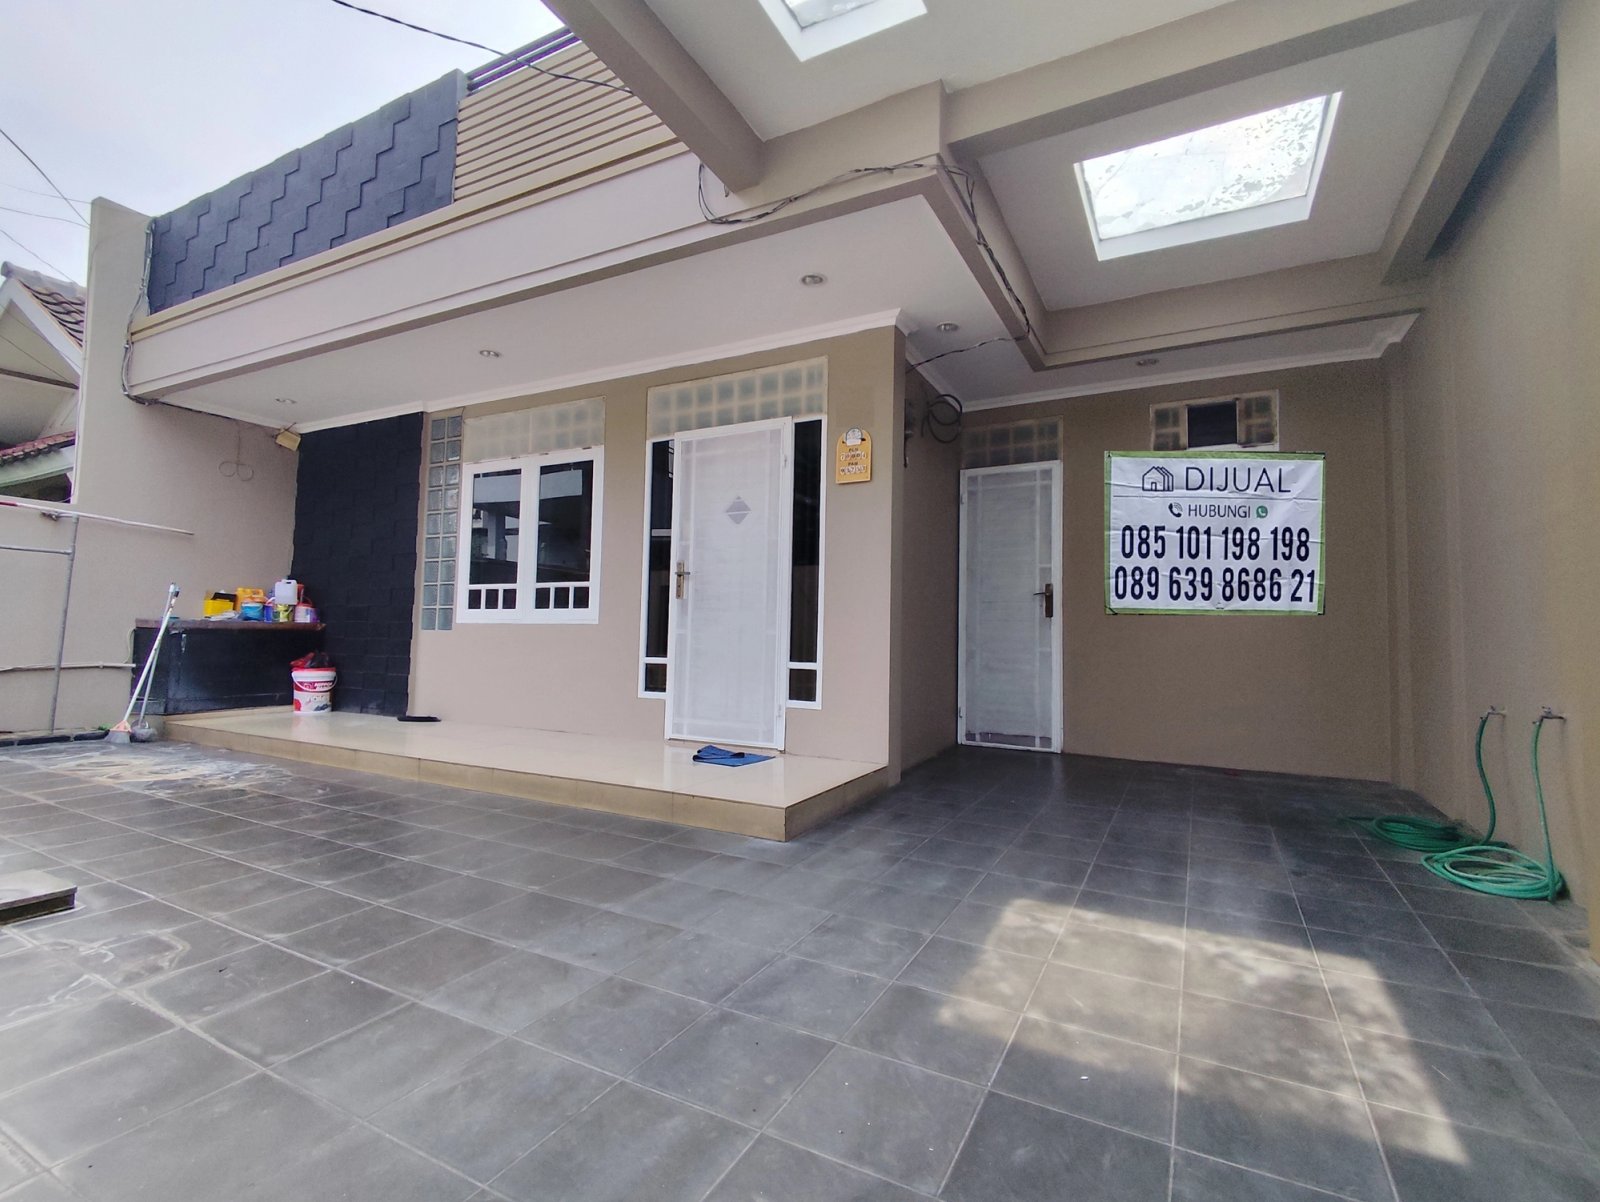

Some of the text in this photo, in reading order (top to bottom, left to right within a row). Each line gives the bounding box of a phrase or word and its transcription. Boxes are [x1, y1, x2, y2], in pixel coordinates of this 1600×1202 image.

[1186, 467, 1291, 493] DIJUAL
[1188, 505, 1251, 518] HUBUNGI
[1121, 525, 1309, 562] 085 101 198 198
[1115, 566, 1315, 602] 089 639 8686 21
